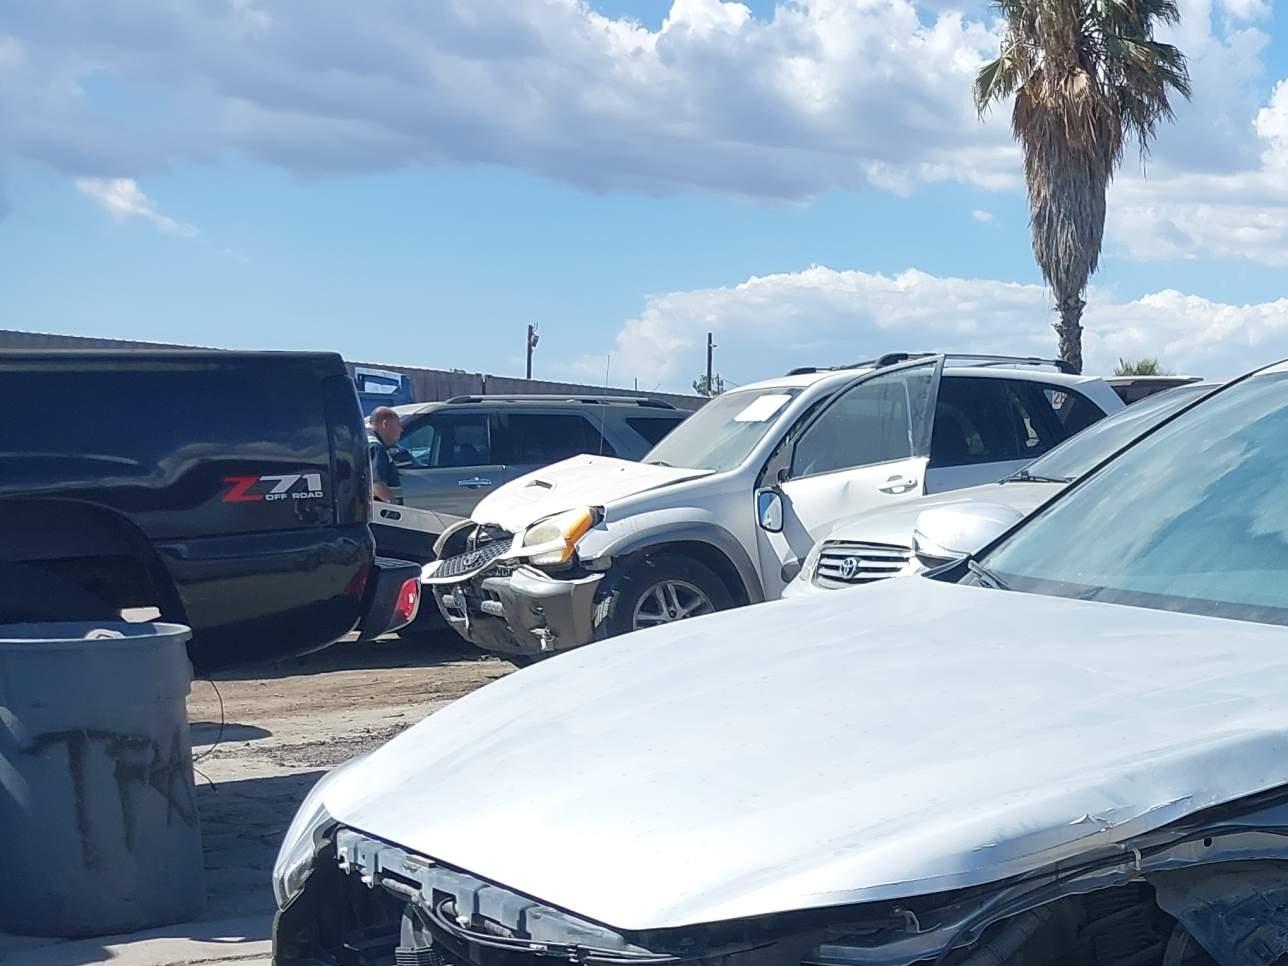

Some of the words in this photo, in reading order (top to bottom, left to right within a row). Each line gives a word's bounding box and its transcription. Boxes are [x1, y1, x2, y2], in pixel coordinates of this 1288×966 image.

[223, 474, 322, 502] Z71
[265, 493, 288, 501] OFF
[292, 491, 324, 499] ROAD
